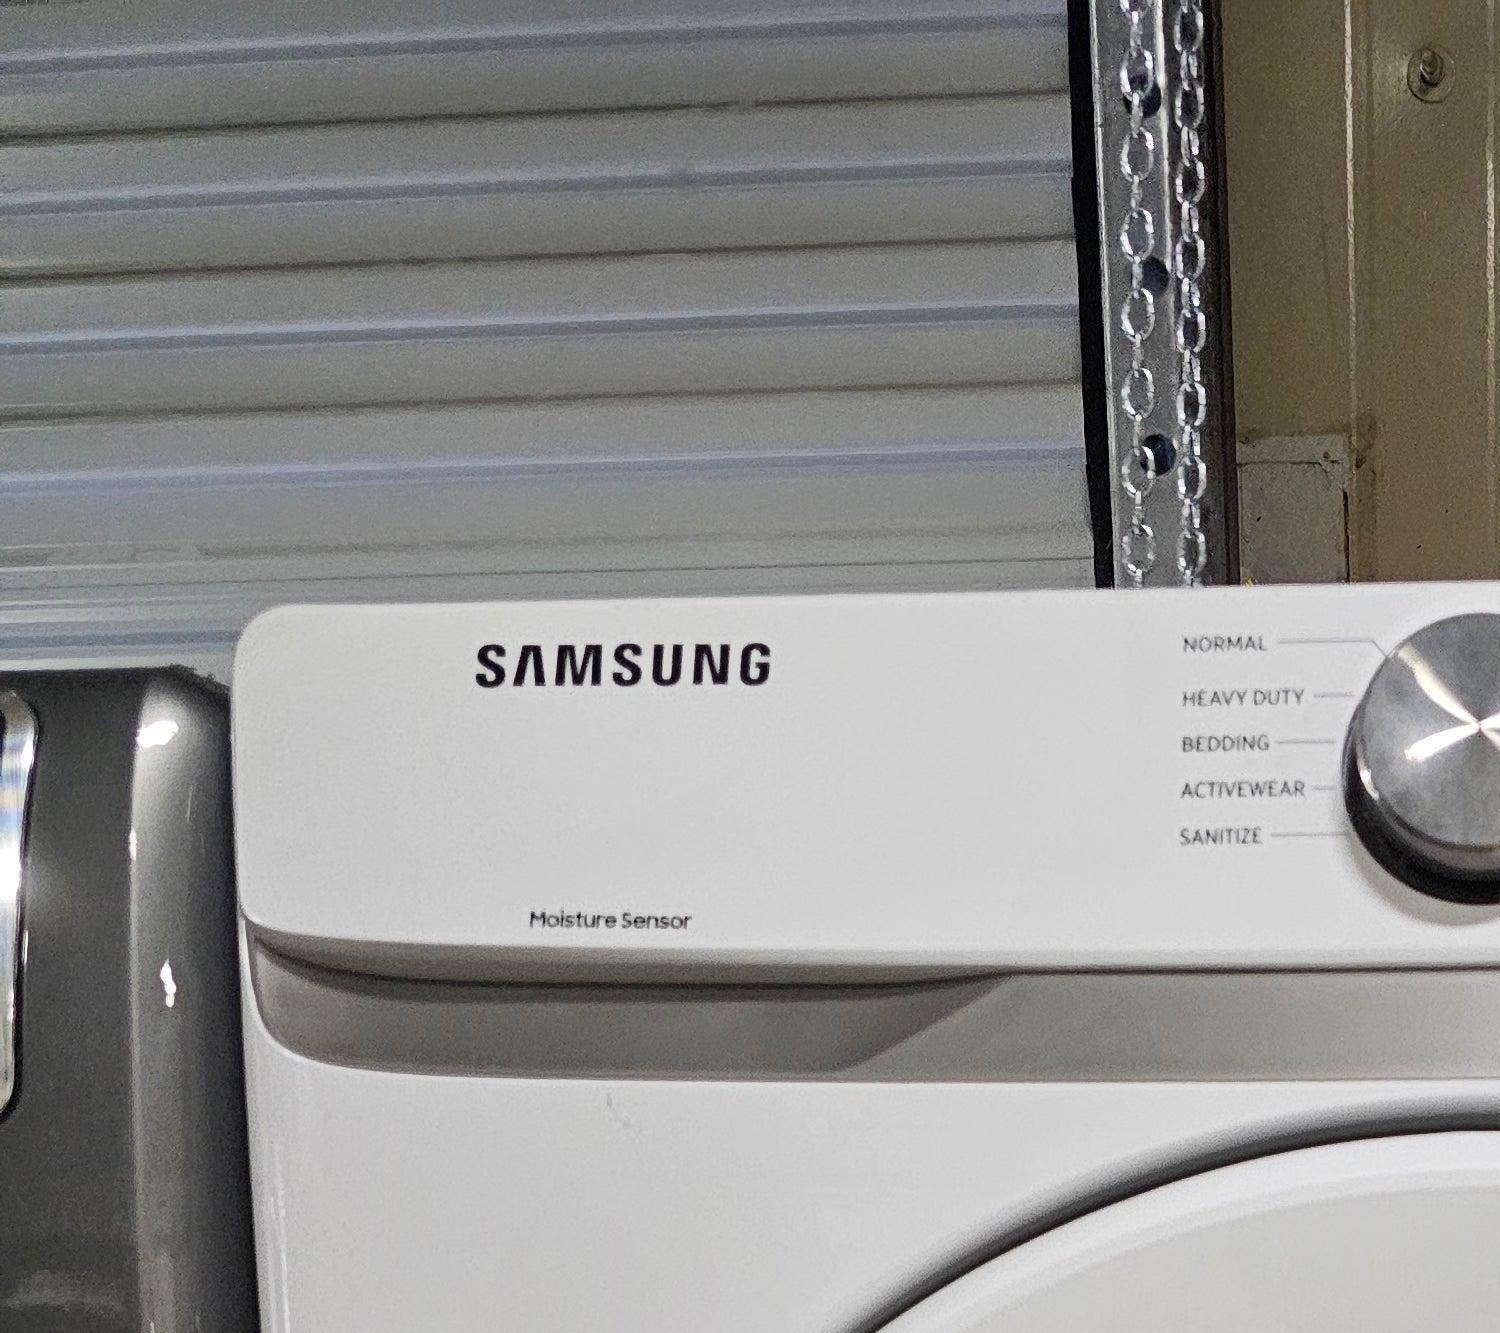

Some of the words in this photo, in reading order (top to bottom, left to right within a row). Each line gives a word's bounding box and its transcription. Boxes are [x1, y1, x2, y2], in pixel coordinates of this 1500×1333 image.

[1183, 635, 1267, 653] NORMAL
[475, 642, 771, 689] SAMSUNG
[1182, 688, 1248, 707] HEAVY
[1251, 687, 1305, 707] DUTY
[1181, 733, 1270, 753] BEDDING
[1180, 779, 1305, 799] ACTIVEWEAR
[1179, 826, 1262, 846] SANITIZE
[529, 910, 618, 929] Moisture
[621, 911, 693, 930] Sensor
